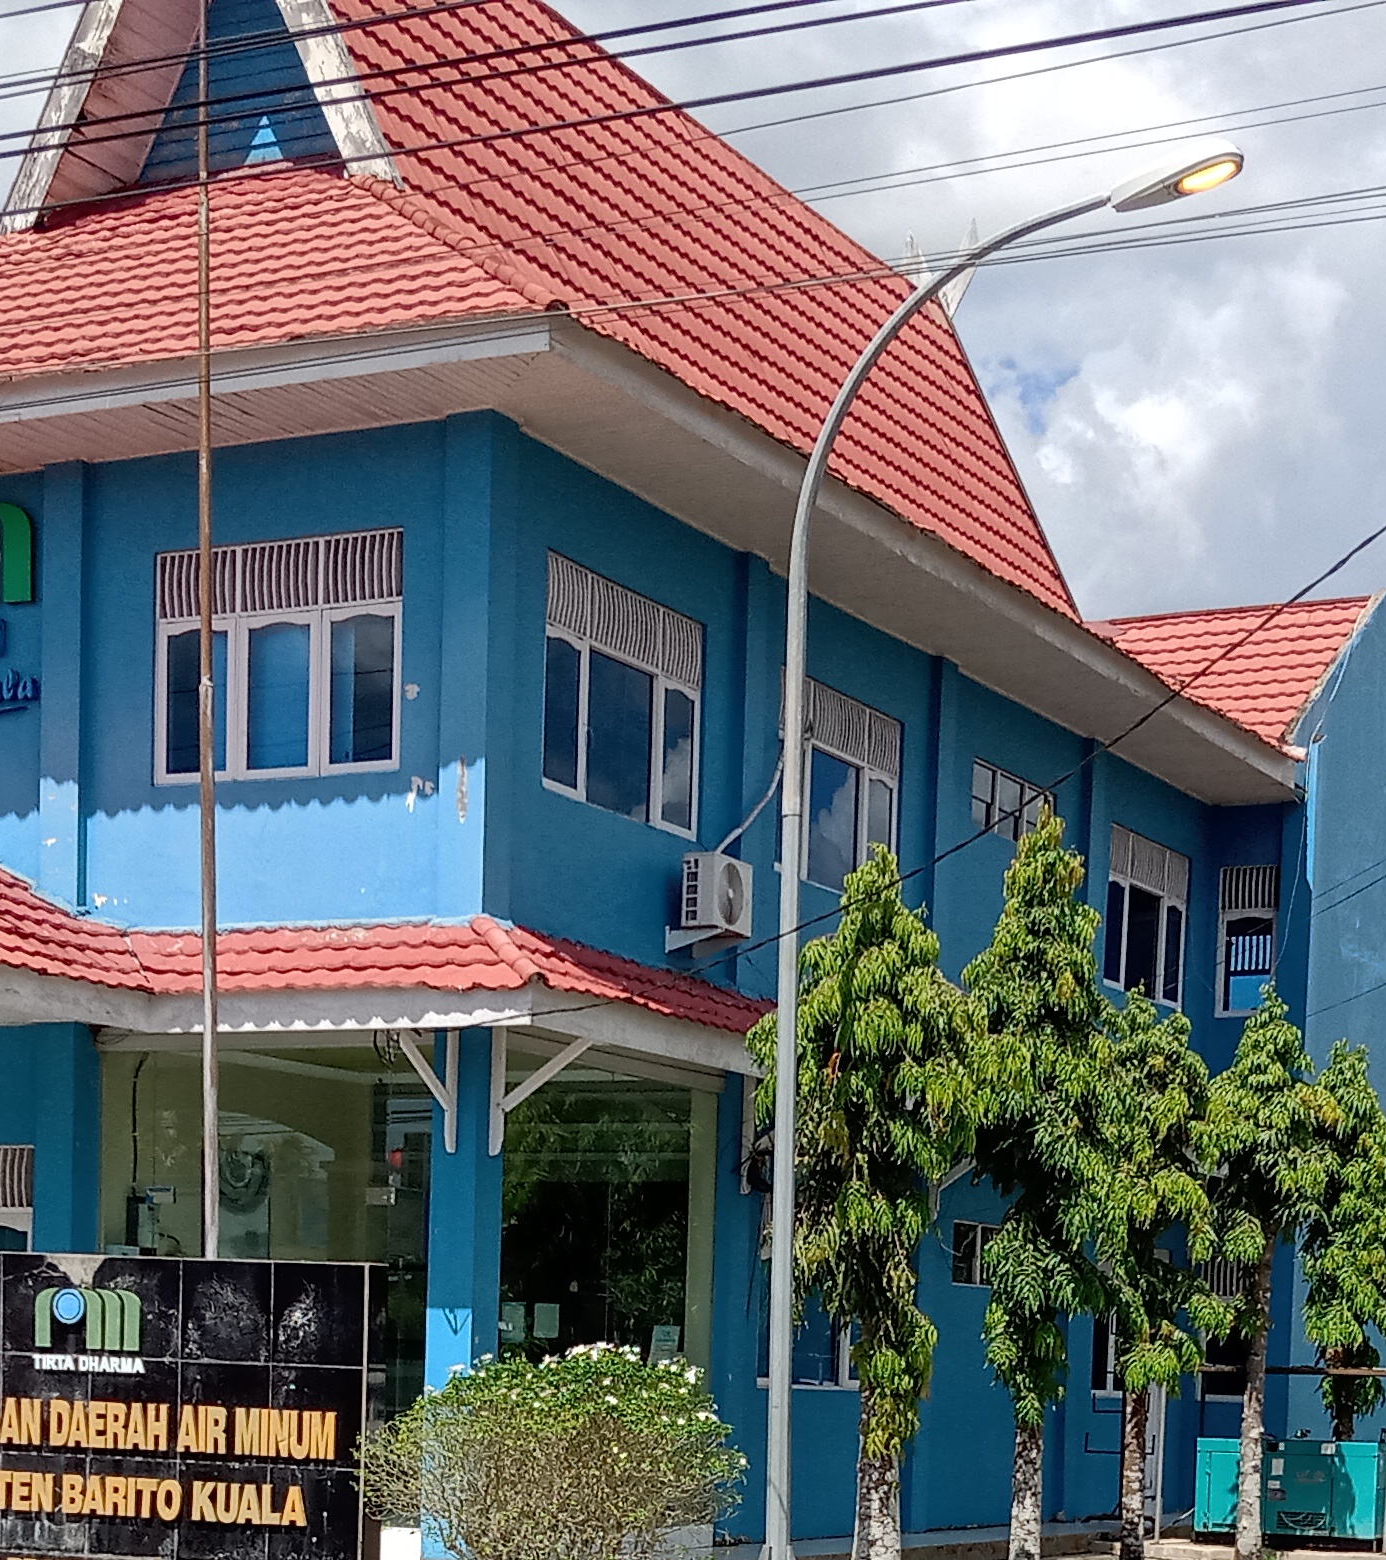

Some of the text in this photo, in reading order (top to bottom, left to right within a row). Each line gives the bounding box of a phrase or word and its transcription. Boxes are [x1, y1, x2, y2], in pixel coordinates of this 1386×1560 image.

[32, 1352, 146, 1374] TIRTA DHARMA
[49, 1398, 170, 1451] DAERAH
[177, 1403, 228, 1455] AIR
[234, 1407, 338, 1460] MINUM
[61, 1473, 183, 1522] BARITO
[191, 1480, 308, 1527] KUALA
